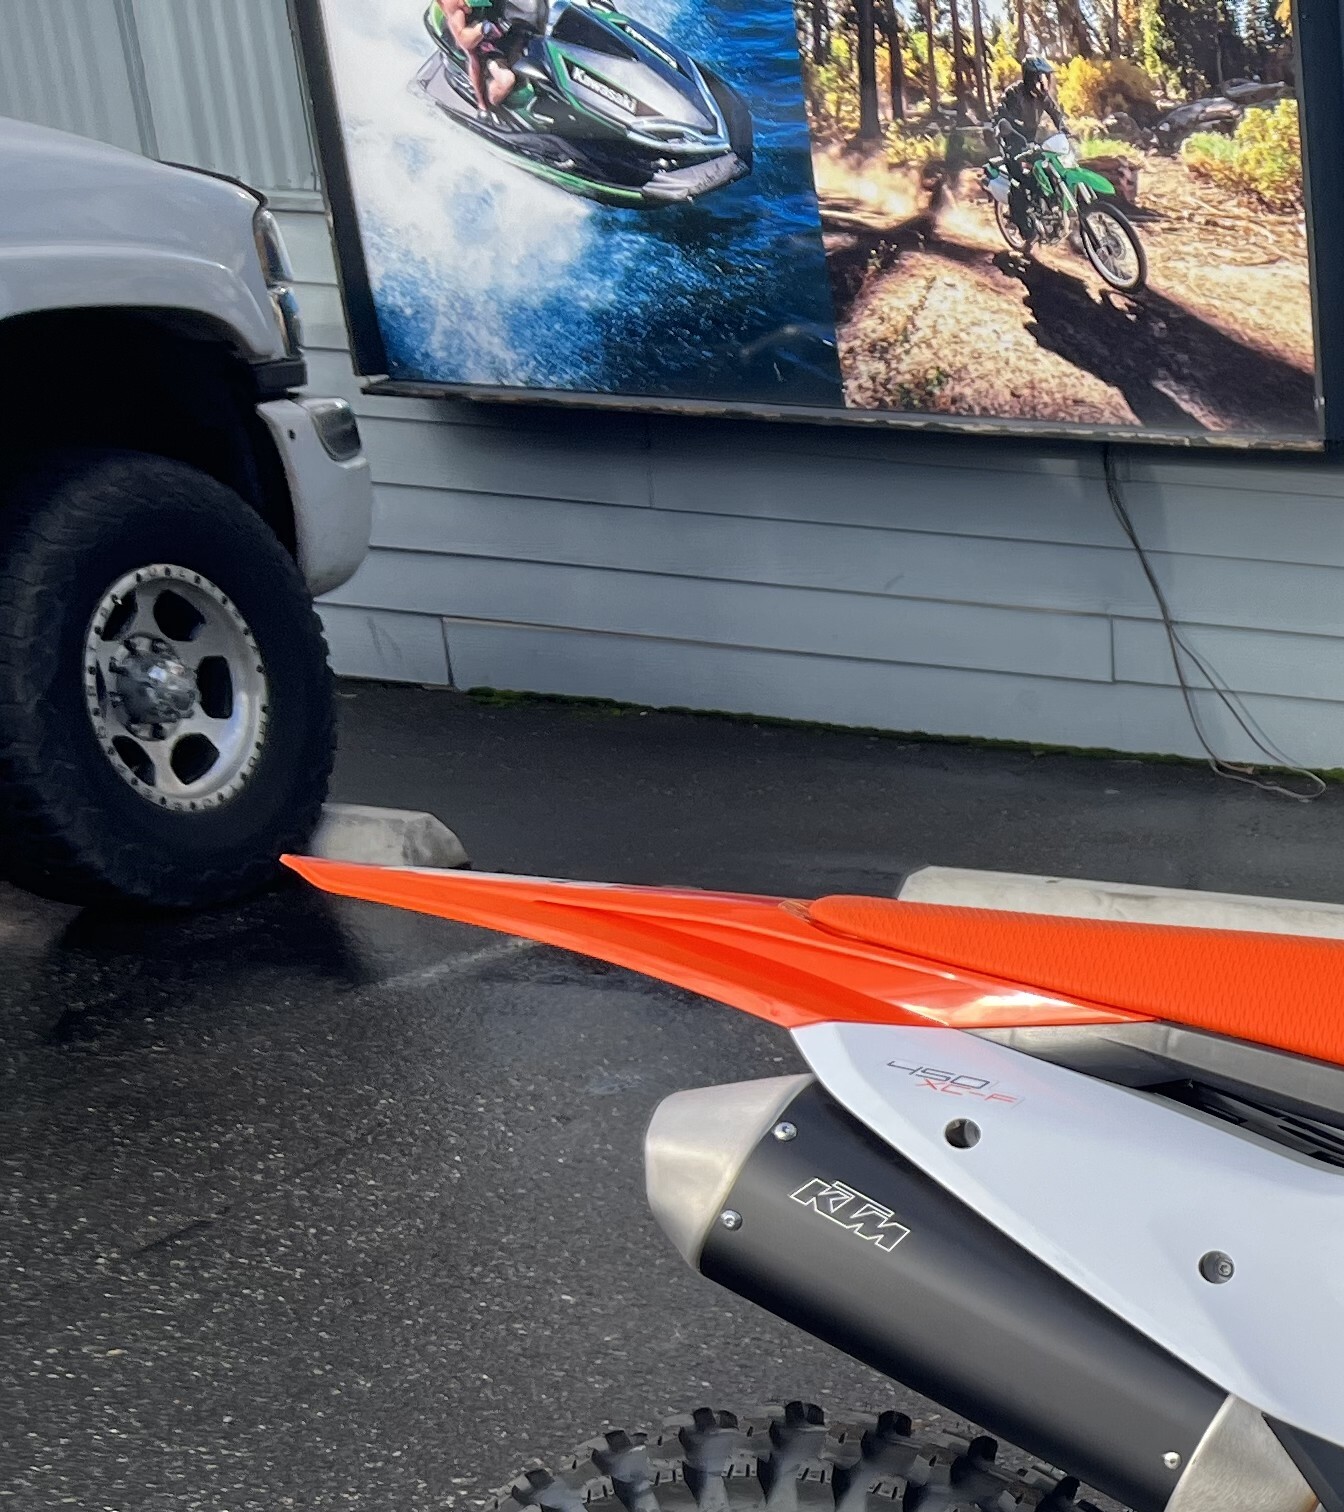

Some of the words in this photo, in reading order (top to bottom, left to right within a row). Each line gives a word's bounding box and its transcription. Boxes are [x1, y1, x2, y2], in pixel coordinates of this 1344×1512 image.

[886, 1060, 991, 1090] 450
[914, 1077, 1019, 1104] XC-F
[789, 1176, 911, 1252] KTM
